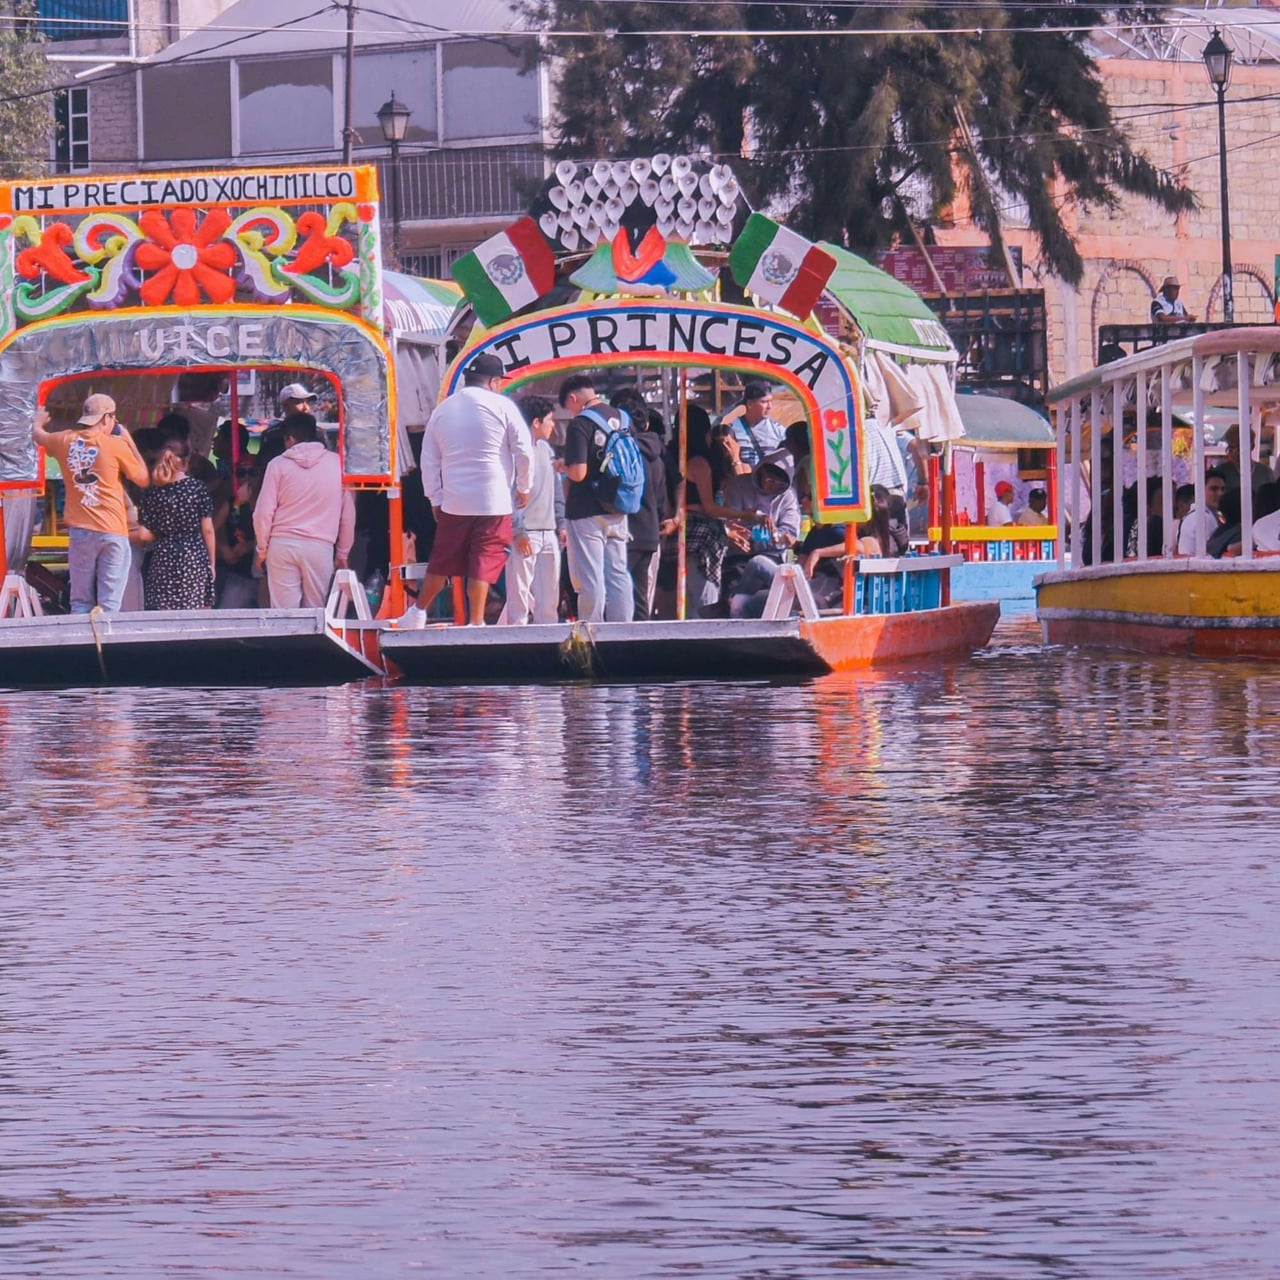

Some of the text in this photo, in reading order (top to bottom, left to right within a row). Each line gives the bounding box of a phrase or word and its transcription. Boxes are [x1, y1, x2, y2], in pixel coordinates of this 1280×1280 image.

[14, 171, 355, 211] MI PRECIADO XOCHIMILCO
[140, 323, 264, 361] VICE
[548, 313, 830, 391] PRINCESA
